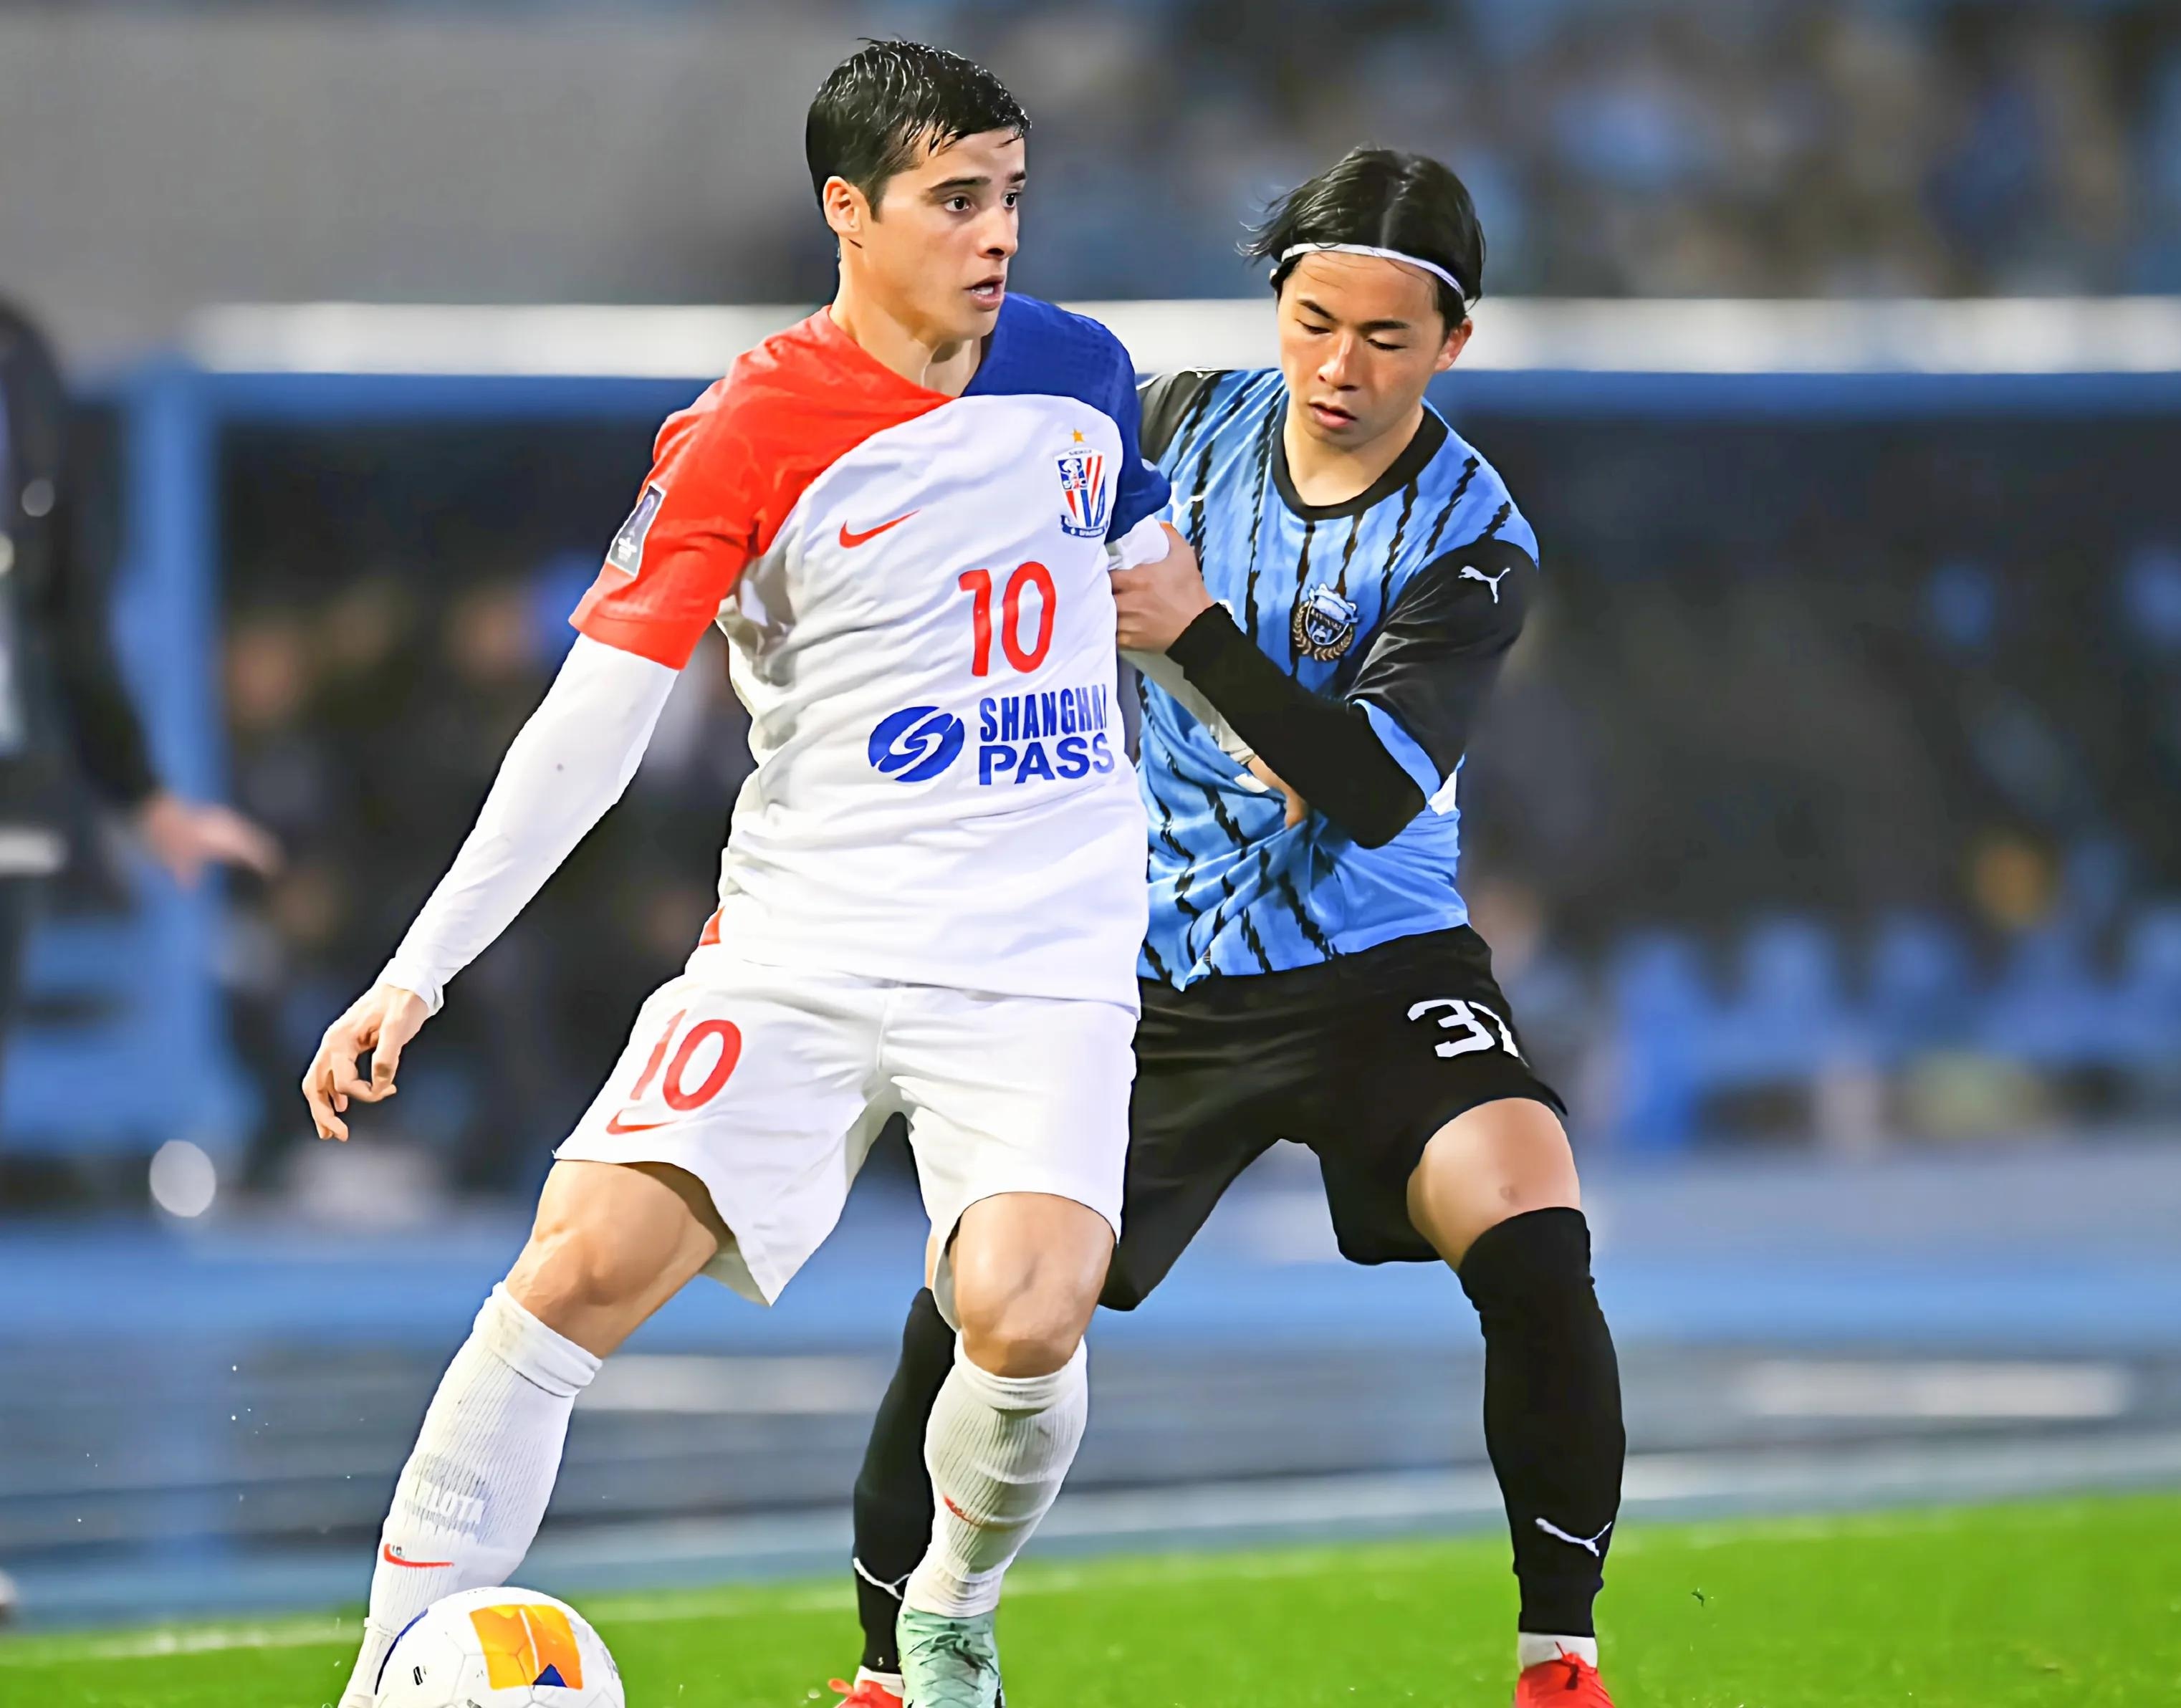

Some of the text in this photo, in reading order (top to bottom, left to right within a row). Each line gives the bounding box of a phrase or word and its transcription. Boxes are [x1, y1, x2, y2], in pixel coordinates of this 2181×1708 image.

[959, 561, 1056, 676] 10
[979, 684, 1107, 742] SHANGHAI
[979, 732, 1115, 785] PASS
[630, 1009, 741, 1110] 10
